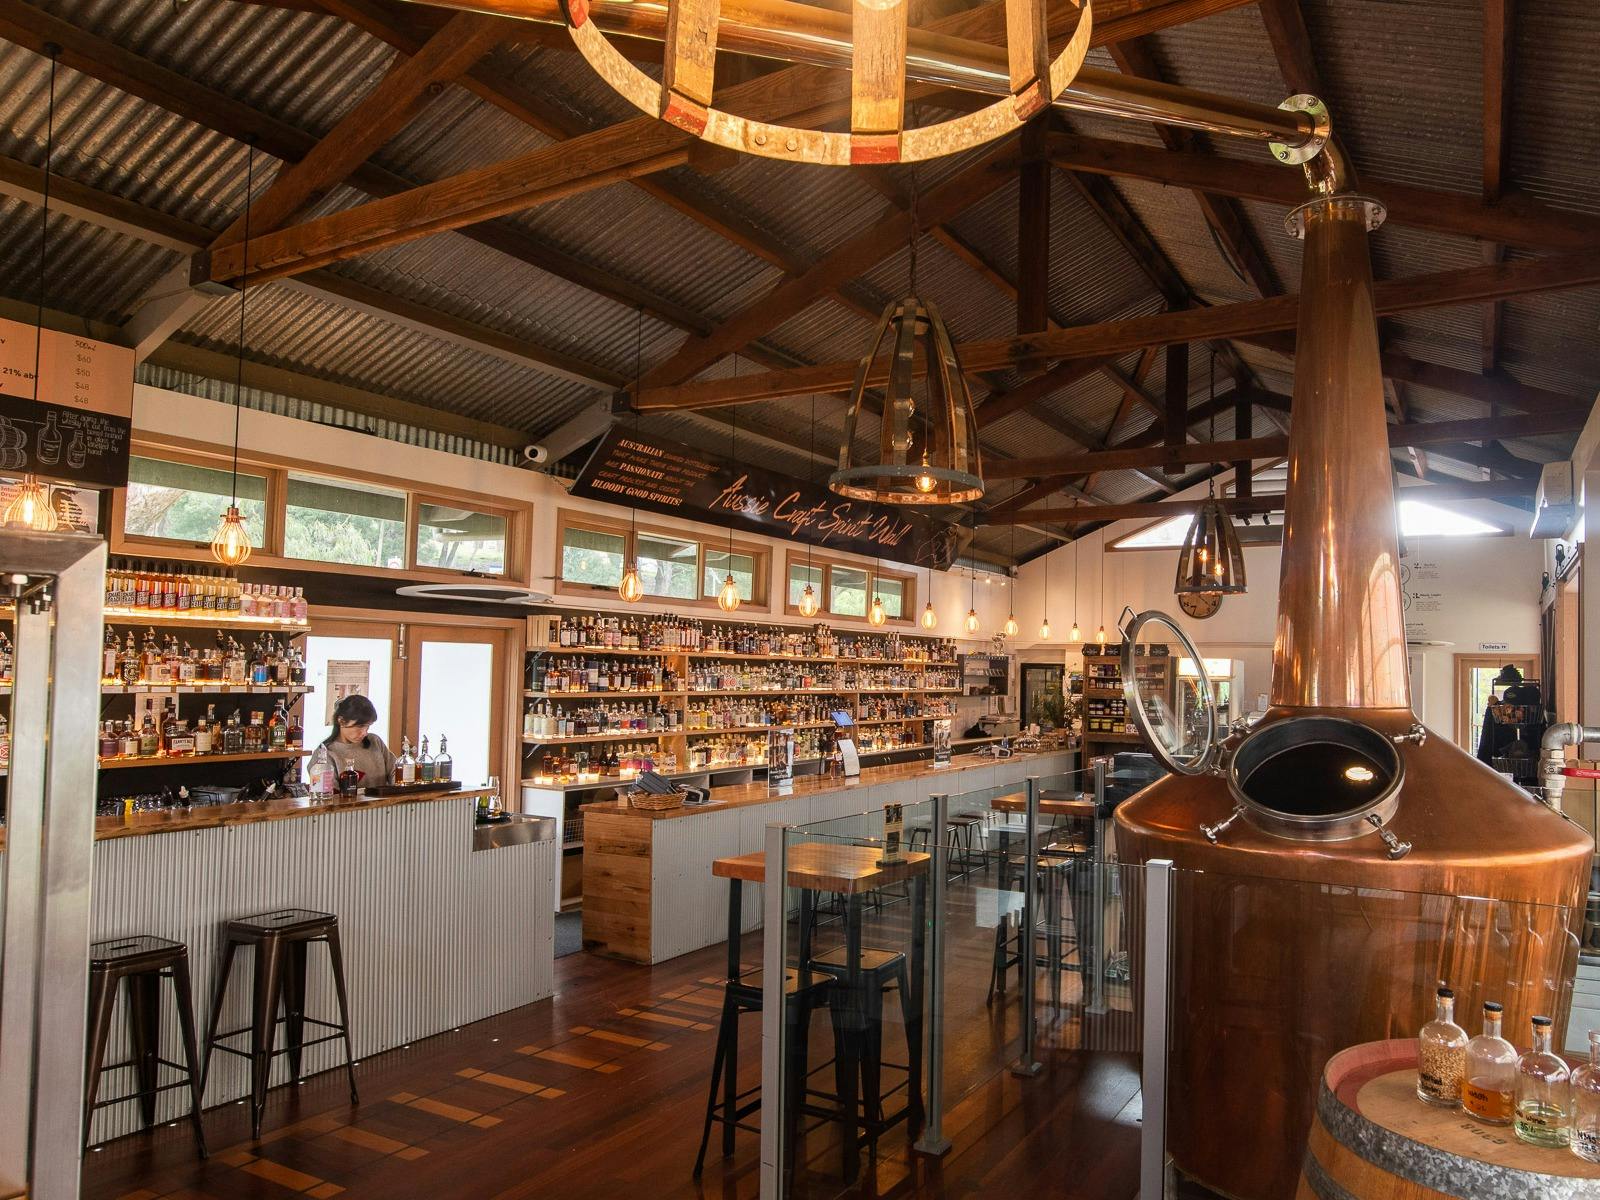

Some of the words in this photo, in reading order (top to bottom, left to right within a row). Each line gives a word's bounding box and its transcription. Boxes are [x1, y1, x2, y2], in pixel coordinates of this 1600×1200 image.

[2, 367, 21, 377] 21%
[617, 439, 665, 457] AUSTRALIAN
[619, 462, 666, 480] PASSIONATE
[591, 478, 626, 494] BLOODY
[625, 486, 650, 499] GOOD
[647, 491, 683, 507] SPIRITS!
[708, 474, 769, 516] Aussie
[773, 491, 827, 535] Craft
[818, 502, 874, 543] Spirit
[869, 515, 913, 547] Wall
